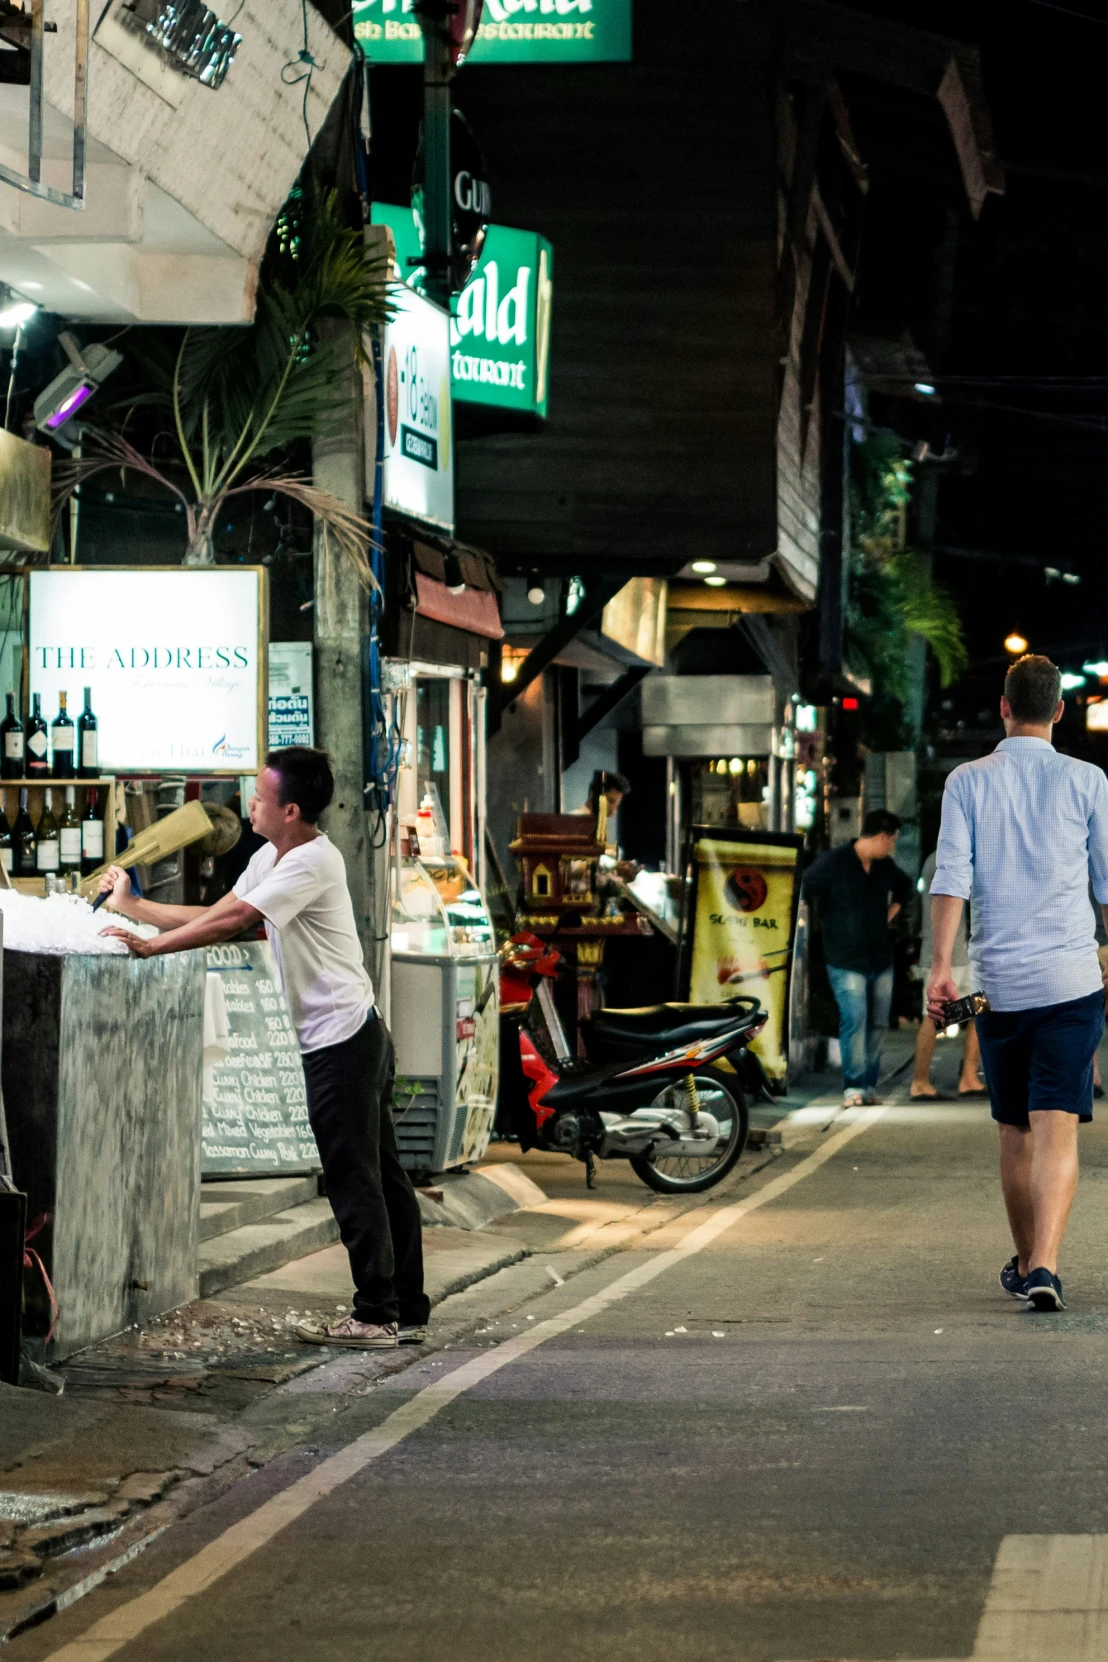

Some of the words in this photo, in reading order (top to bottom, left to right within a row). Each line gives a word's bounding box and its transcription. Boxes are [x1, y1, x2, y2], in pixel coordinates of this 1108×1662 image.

[476, 20, 595, 40] estaurant
[452, 349, 527, 390] taurant
[36, 646, 95, 669] THE
[106, 646, 249, 669] ADDRESS
[753, 917, 779, 930] BAR
[226, 998, 254, 1013] tables
[267, 1031, 288, 1046] 220
[241, 1070, 277, 1088] Chicken
[279, 1071, 300, 1086] 220
[243, 1087, 280, 1104] Chicken
[284, 1087, 304, 1103] 220
[211, 1103, 243, 1126] Curry
[246, 1104, 283, 1123] Chicken
[288, 1105, 309, 1121] 220
[217, 1121, 247, 1138] Mixed
[248, 1122, 296, 1144] Vegetables
[250, 1142, 279, 1166] Curry
[277, 1141, 299, 1161] Pork
[300, 1142, 320, 1159] 220
